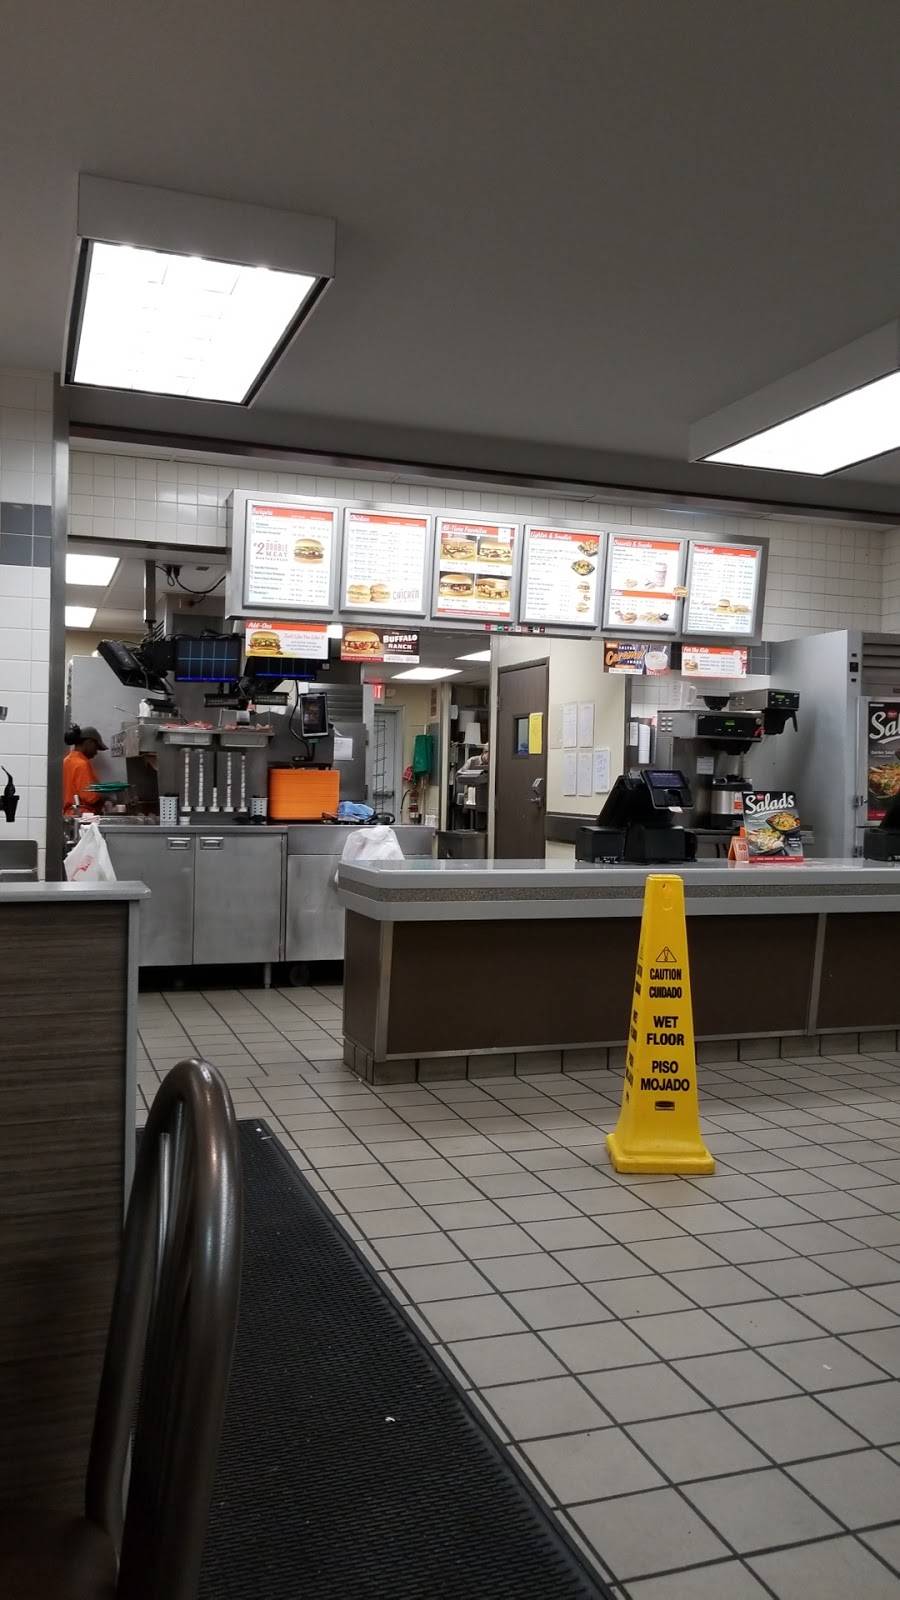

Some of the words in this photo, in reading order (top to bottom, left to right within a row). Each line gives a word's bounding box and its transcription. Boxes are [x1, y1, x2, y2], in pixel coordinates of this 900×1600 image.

[383, 634, 418, 643] BUFFALO
[745, 792, 794, 814] Salads
[649, 968, 682, 980] CAUTION
[649, 986, 682, 999] CUIDADO
[653, 1016, 679, 1028] WET
[646, 1033, 685, 1046] FLOOR
[652, 1060, 679, 1074] PISO
[640, 1078, 690, 1092] MOJADO
